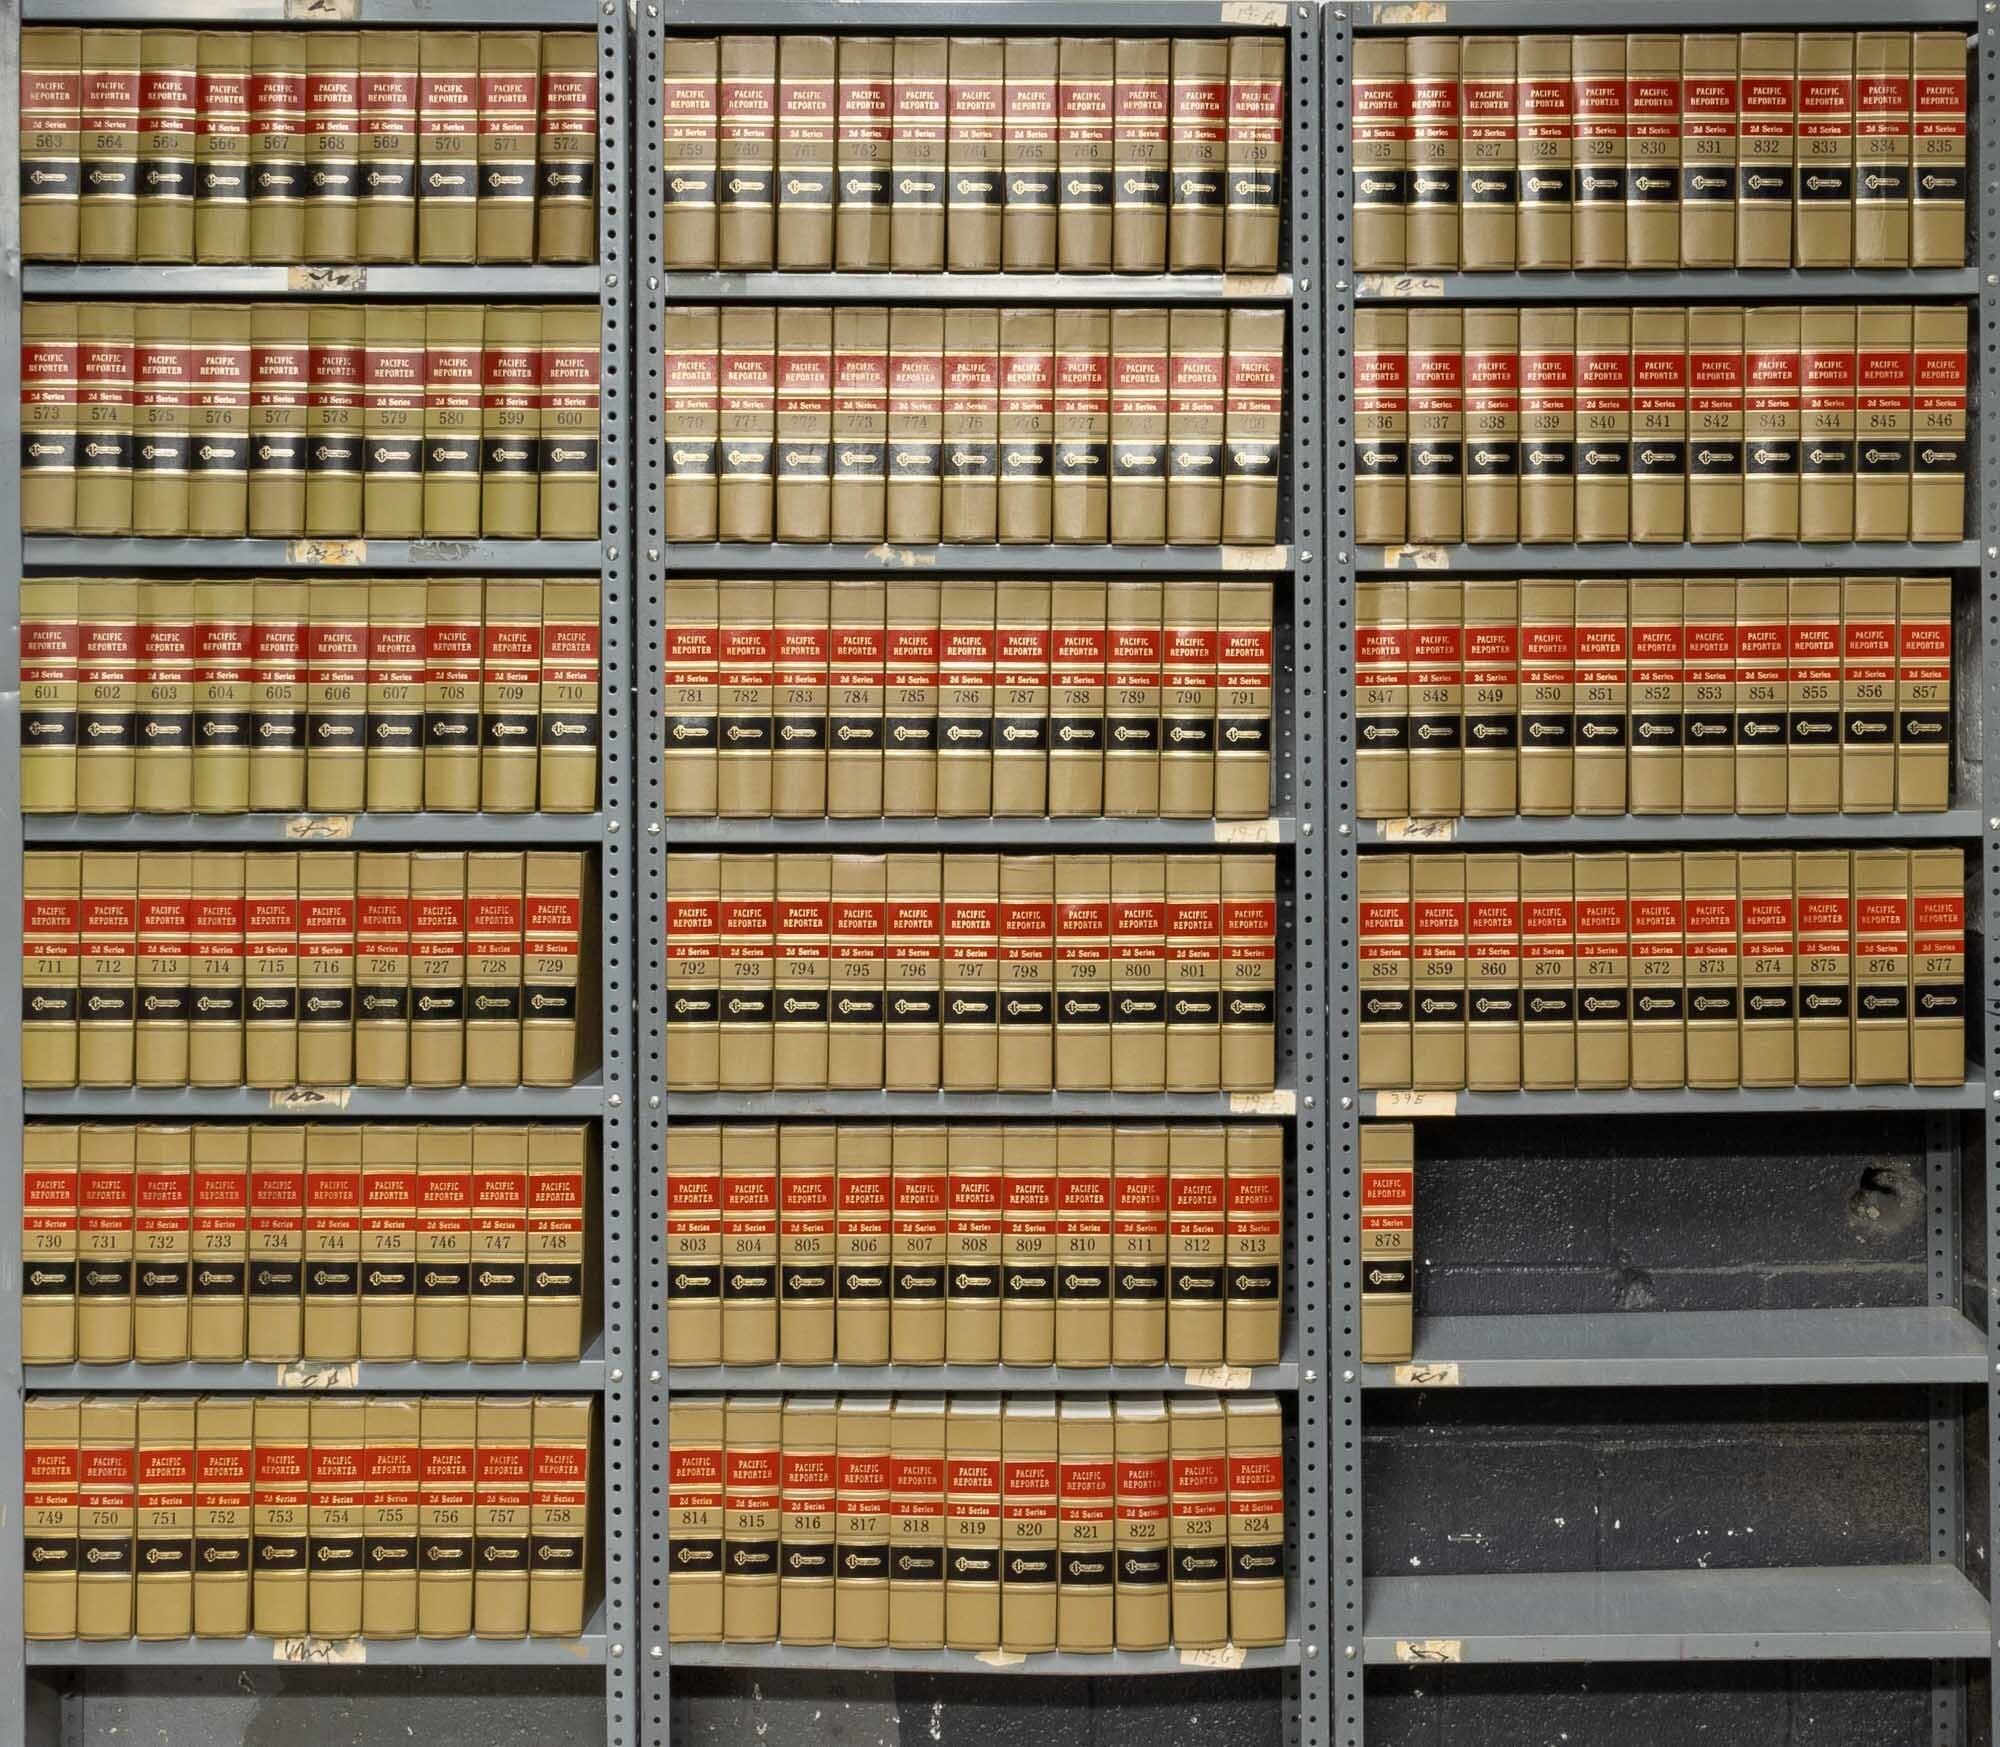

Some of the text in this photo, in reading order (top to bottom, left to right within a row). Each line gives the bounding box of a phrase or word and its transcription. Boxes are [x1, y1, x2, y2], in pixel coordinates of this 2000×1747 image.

[434, 84, 463, 93] PACIFIC
[1640, 88, 1668, 96] PACIFIC
[428, 94, 468, 103] REPORTER
[852, 91, 880, 100] PACIFIC
[1634, 98, 1672, 106] REPORTER
[846, 101, 885, 110] REPORTER
[319, 135, 345, 150] 568
[374, 135, 399, 148] 569
[435, 135, 460, 150] 570
[554, 137, 578, 150] 572
[1641, 141, 1666, 154] 830
[1697, 140, 1720, 153] 831
[1754, 139, 1779, 153] 832
[1812, 140, 1837, 154] 833
[1927, 139, 1952, 152] 835
[1476, 143, 1501, 156] 827
[439, 358, 468, 367] PACIFIC
[734, 362, 762, 371] PACIFIC
[1702, 362, 1731, 370] PACIFIC
[434, 368, 473, 377] REPORTER
[728, 372, 768, 381] REPORTER
[1696, 372, 1736, 380] REPORTER
[447, 398, 469, 406] Series
[323, 409, 348, 423] 578
[381, 410, 407, 424] 579
[439, 410, 464, 424] 580
[557, 411, 582, 424] 600
[1590, 415, 1615, 428] 840
[1646, 414, 1669, 428] 841
[1704, 414, 1729, 428] 842
[1816, 414, 1840, 427] 844
[1927, 413, 1952, 426] 846
[93, 632, 123, 641] PACIFIC
[677, 636, 706, 644] PACIFIC
[1009, 637, 1038, 646] PACIFIC
[1643, 633, 1672, 642] PACIFIC
[88, 642, 127, 651] REPORTER
[672, 646, 711, 654] REPORTER
[1003, 647, 1042, 656] REPORTER
[1637, 643, 1676, 652] REPORTER
[101, 672, 124, 680] Series
[686, 674, 708, 682] Series
[1018, 676, 1039, 684] Series
[1652, 672, 1674, 680] Series
[35, 685, 57, 698] 601
[94, 686, 120, 699] 602
[208, 686, 234, 699] 604
[325, 686, 350, 700] 606
[440, 686, 464, 699] 708
[558, 686, 582, 699] 710
[678, 689, 702, 702] 781
[787, 690, 813, 703] 783
[900, 690, 925, 702] 785
[1009, 690, 1035, 703] 787
[1120, 690, 1145, 704] 789
[1231, 691, 1254, 704] 791
[1478, 689, 1503, 702] 849
[1536, 687, 1560, 700] 850
[1645, 686, 1670, 699] 852
[1802, 686, 1827, 699] 855
[1913, 685, 1938, 698] 857
[151, 906, 180, 915] PACIFIC
[957, 910, 985, 919] PACIFIC
[1533, 908, 1562, 916] PACIFIC
[145, 916, 185, 925] REPORTER
[952, 920, 990, 929] REPORTER
[1528, 918, 1567, 926] REPORTER
[159, 945, 181, 953] Series
[966, 949, 987, 957] Series
[38, 960, 61, 973] 711
[152, 959, 177, 972] 713
[259, 959, 284, 973] 715
[313, 960, 339, 973] 716
[424, 960, 449, 974] 727
[538, 959, 563, 972] 729
[680, 961, 705, 975] 792
[790, 961, 814, 975] 794
[900, 964, 926, 976] 796
[958, 964, 983, 976] 797
[1071, 964, 1096, 978] 799
[1235, 964, 1261, 977] 802
[1372, 963, 1398, 976] 858
[1481, 962, 1506, 976] 860
[1536, 962, 1561, 975] 870
[1699, 960, 1724, 973] 873
[1811, 958, 1836, 972] 875
[1926, 958, 1952, 972] 877
[375, 1181, 403, 1190] PACIFIC
[793, 1184, 822, 1193] PACIFIC
[1373, 1179, 1401, 1188] PACIFIC
[369, 1191, 408, 1200] REPORTER
[788, 1194, 827, 1204] REPORTER
[1367, 1189, 1406, 1198] REPORTER
[384, 1220, 405, 1228] Series
[802, 1224, 824, 1232] Series
[36, 1235, 62, 1248] 730
[148, 1235, 174, 1248] 732
[264, 1234, 287, 1247] 734
[320, 1236, 344, 1248] 744
[376, 1234, 400, 1248] 745
[541, 1235, 566, 1248] 748
[680, 1238, 706, 1251] 803
[795, 1238, 820, 1251] 805
[907, 1237, 933, 1251] 807
[1016, 1238, 1042, 1251] 809
[1128, 1238, 1151, 1251] 811
[1240, 1239, 1266, 1252] 813
[1375, 1233, 1400, 1247] 878
[209, 1457, 239, 1466] PACIFIC
[204, 1467, 244, 1476] REPORTER
[959, 1468, 987, 1476] PACIFIC
[954, 1478, 992, 1486] REPORTER
[219, 1496, 240, 1504] Series
[209, 1510, 235, 1524] 752
[324, 1509, 349, 1522] 754
[433, 1510, 458, 1523] 756
[545, 1509, 570, 1522] 758
[968, 1506, 989, 1515] Series
[38, 1511, 63, 1524] 749
[152, 1512, 176, 1525] 751
[682, 1511, 707, 1524] 814
[795, 1516, 821, 1529] 816
[903, 1520, 929, 1532] 818
[960, 1521, 986, 1534] 819
[1130, 1524, 1155, 1537] 822
[1244, 1518, 1269, 1531] 824
